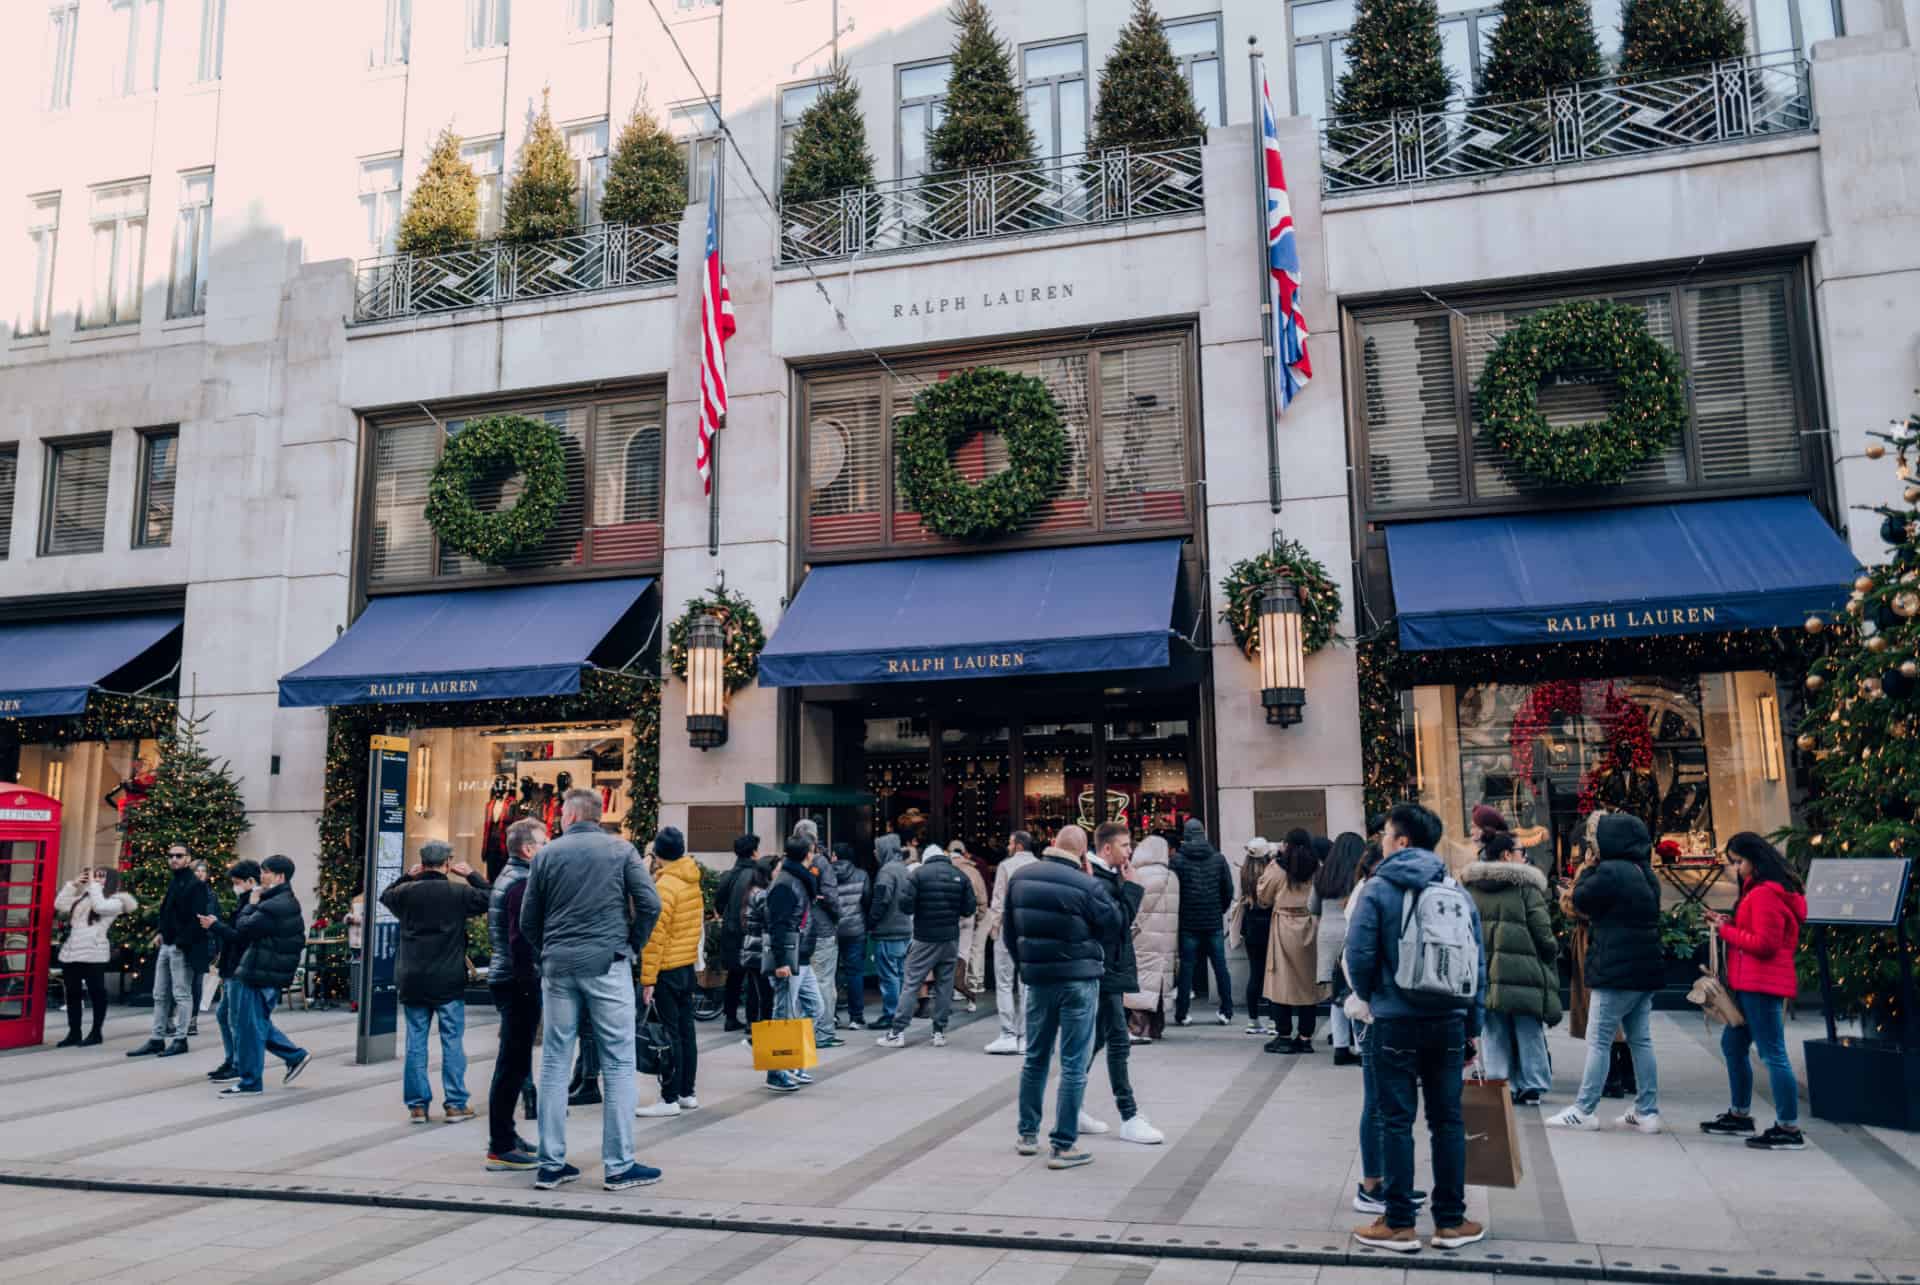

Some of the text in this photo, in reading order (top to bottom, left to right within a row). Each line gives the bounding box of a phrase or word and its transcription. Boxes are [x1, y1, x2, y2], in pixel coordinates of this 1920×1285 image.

[893, 284, 1074, 318] RALPH LAUREN
[1547, 607, 1716, 633] RALPH LAUREN
[888, 652, 1024, 673] RALPH LAUREN
[369, 680, 478, 696] RALPH LAUREN
